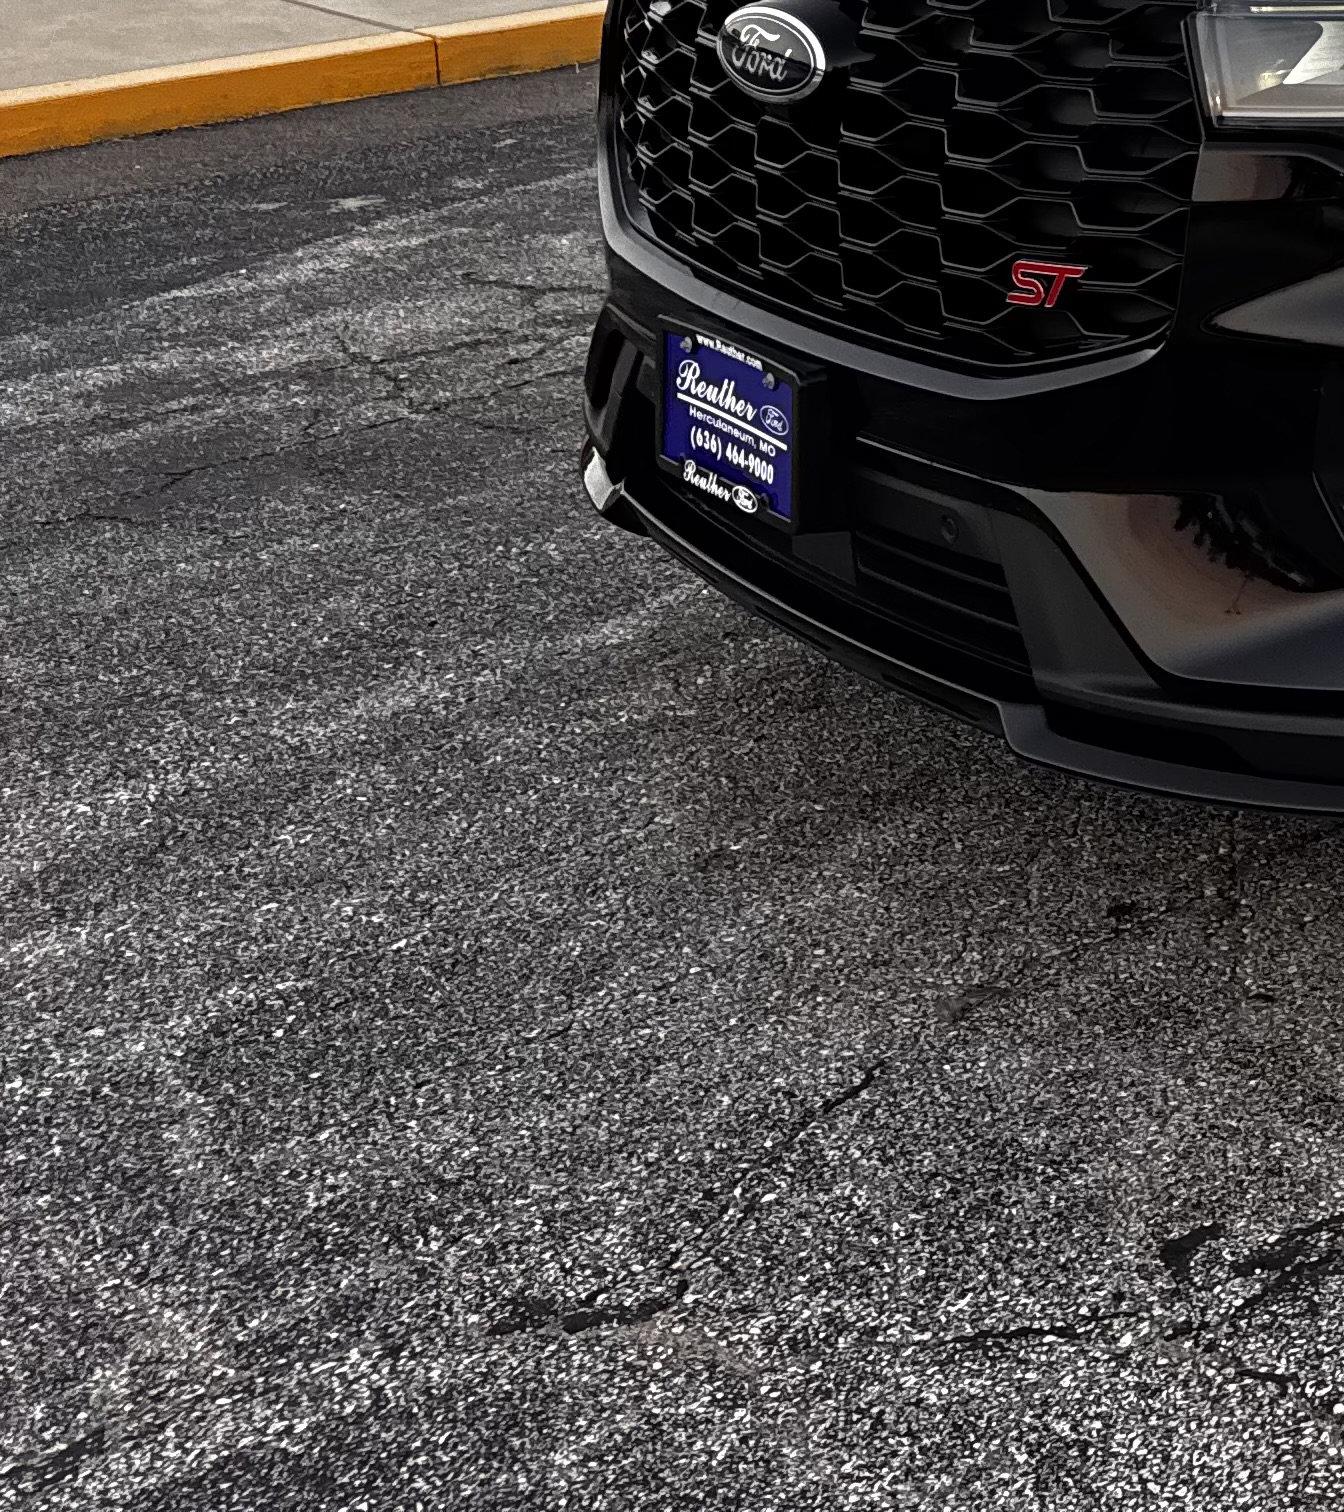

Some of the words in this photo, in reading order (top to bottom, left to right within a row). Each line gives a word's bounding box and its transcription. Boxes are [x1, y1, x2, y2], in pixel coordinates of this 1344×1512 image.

[731, 23, 793, 82] Ford
[1006, 260, 1088, 308] ST
[675, 358, 758, 423] Reuther
[690, 425, 723, 461] (636)
[725, 441, 774, 485] 464-9000
[759, 438, 776, 457] MO
[682, 459, 732, 502] Reuther
